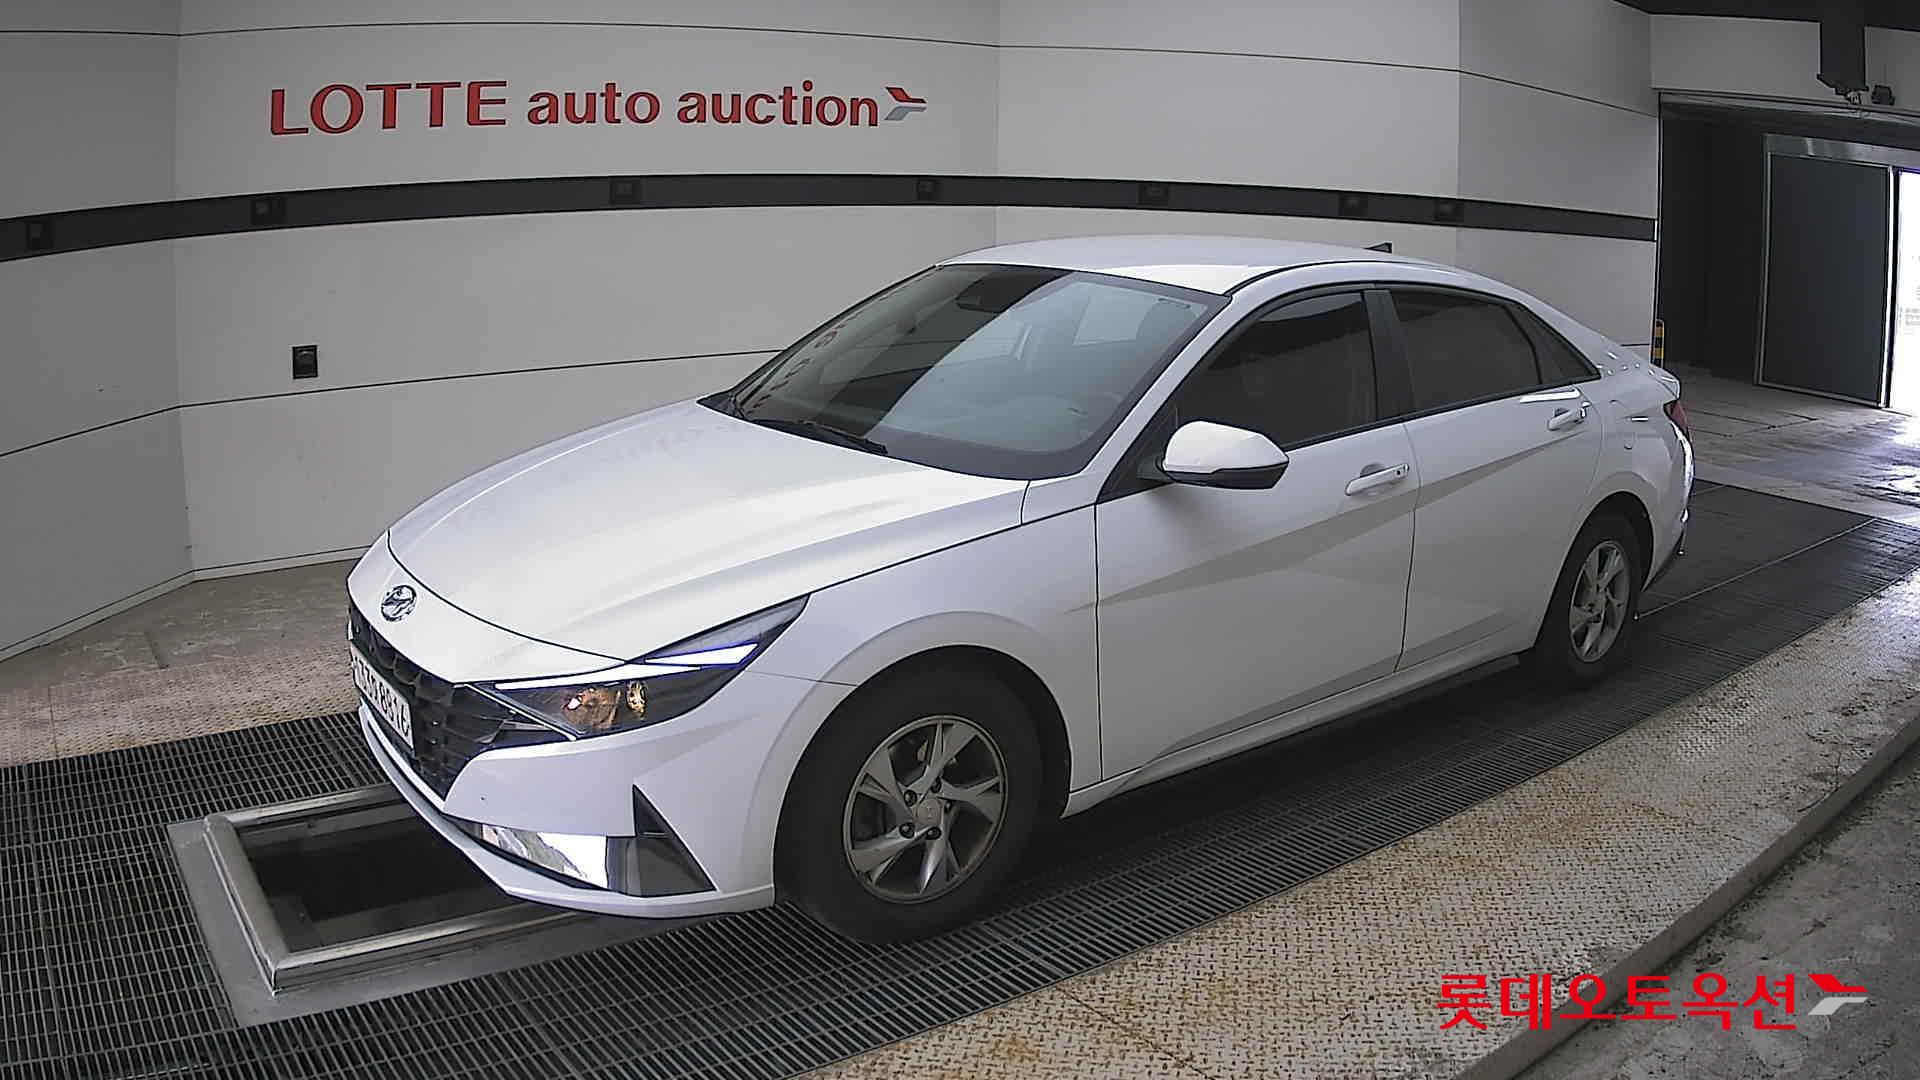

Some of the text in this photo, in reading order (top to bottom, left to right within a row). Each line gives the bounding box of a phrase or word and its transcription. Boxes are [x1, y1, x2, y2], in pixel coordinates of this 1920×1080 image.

[270, 80, 880, 136] LOTTE auto auction
